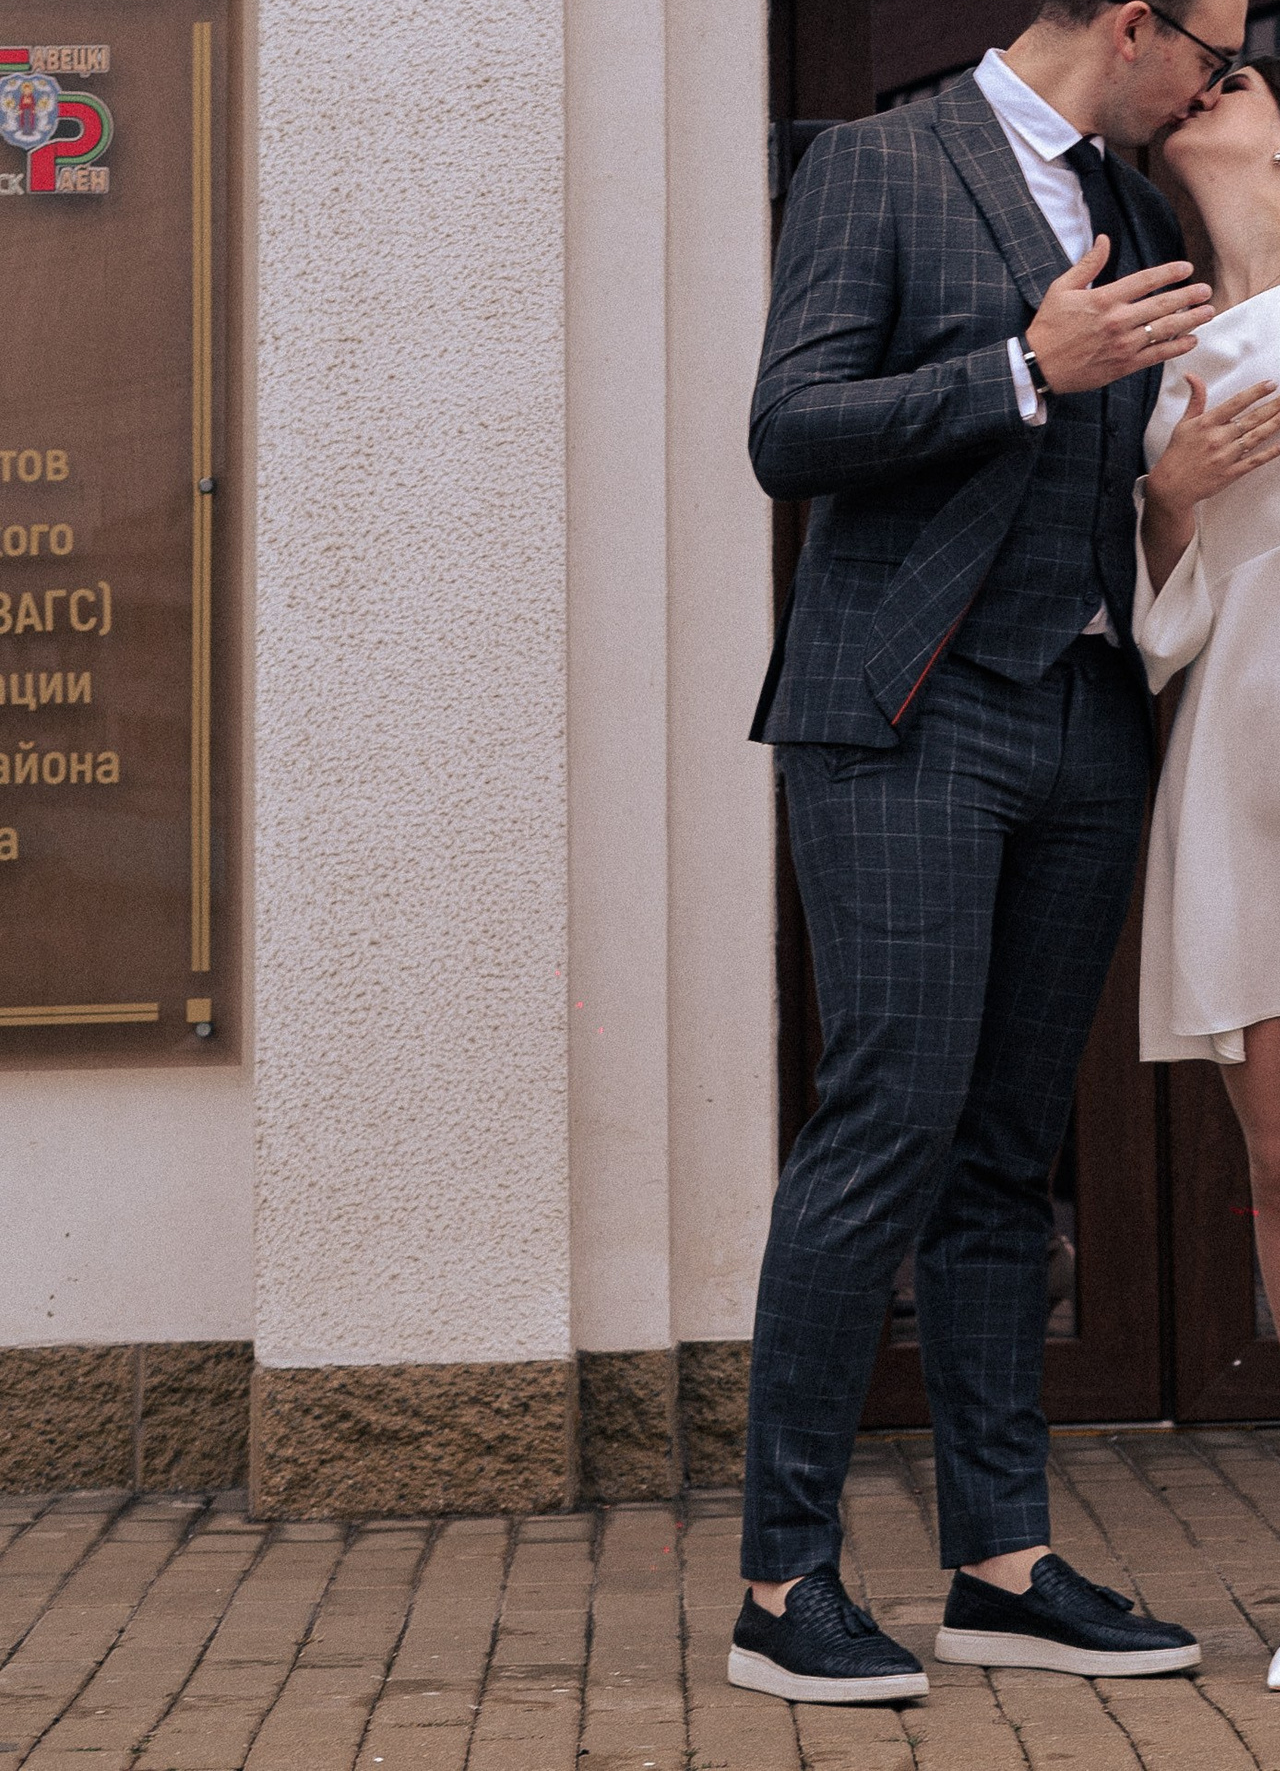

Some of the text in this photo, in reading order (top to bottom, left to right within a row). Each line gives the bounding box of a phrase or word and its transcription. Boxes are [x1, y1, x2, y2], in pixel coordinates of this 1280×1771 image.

[0, 449, 70, 482] тов
[0, 523, 74, 557] ого
[0, 671, 92, 711] ции
